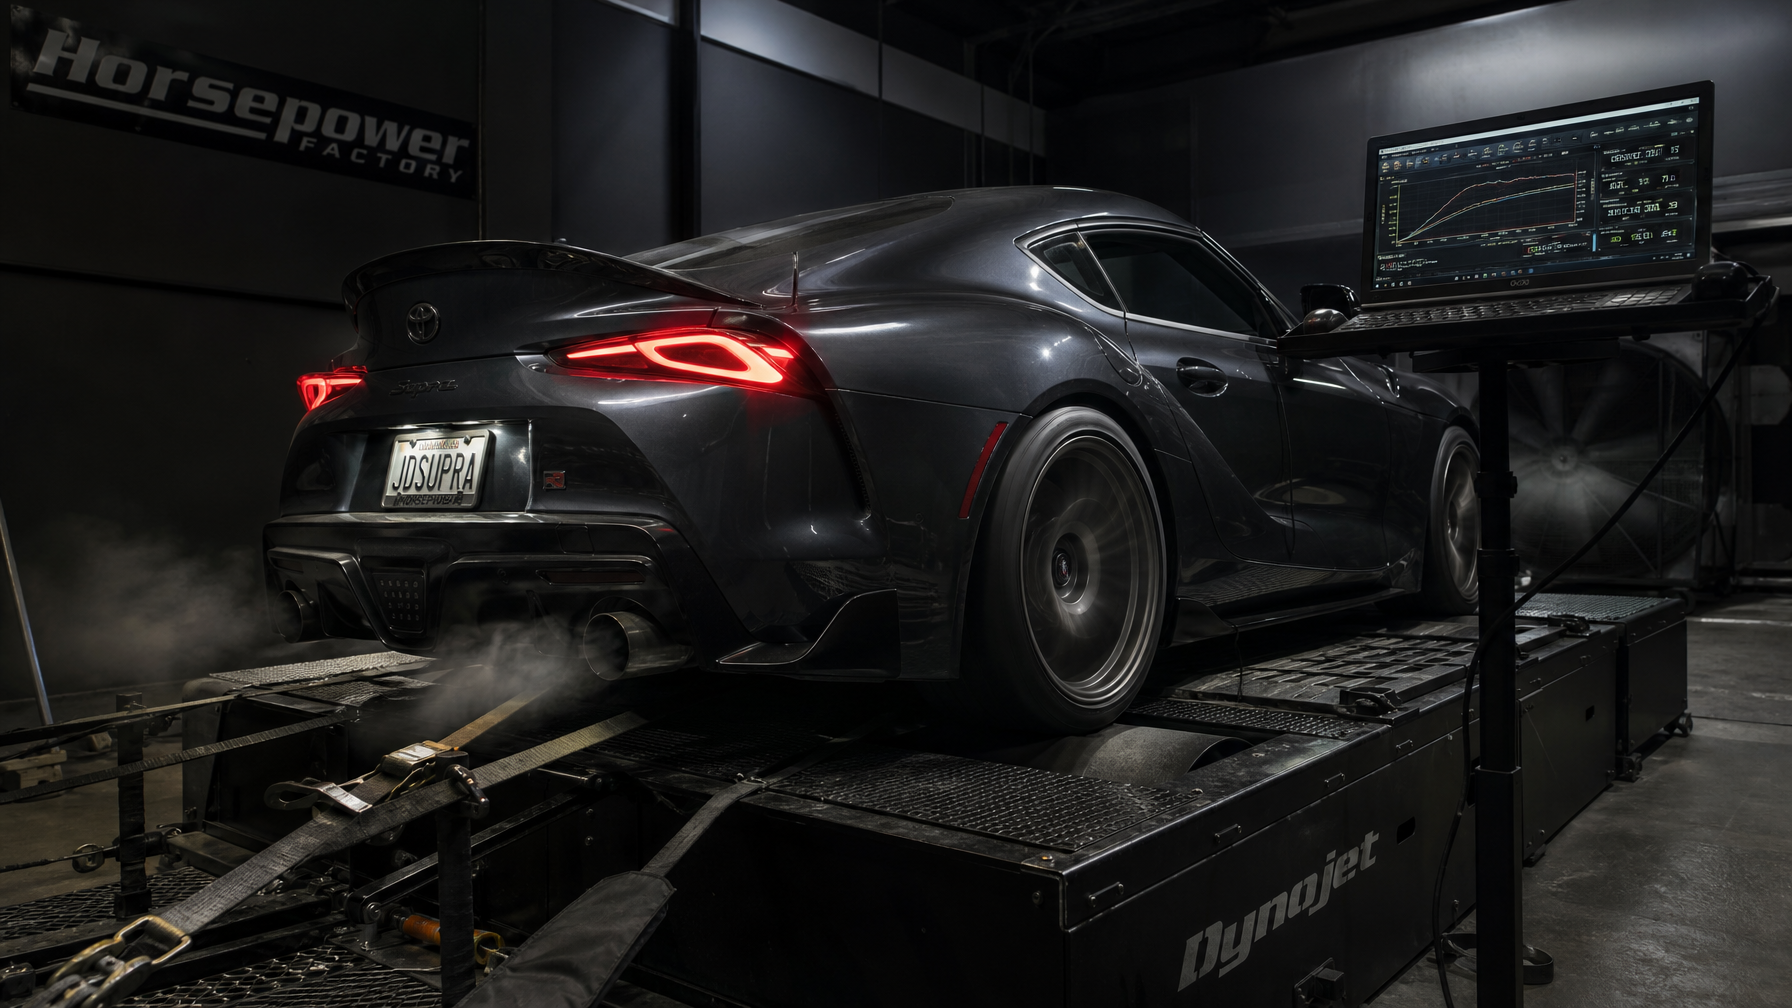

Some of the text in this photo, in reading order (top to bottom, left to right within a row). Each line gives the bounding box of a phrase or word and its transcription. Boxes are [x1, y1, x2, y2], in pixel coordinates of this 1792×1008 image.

[33, 28, 469, 165] Horsepower
[299, 136, 464, 183] FACTORY
[392, 452, 476, 492] JDSUPRA
[1177, 830, 1380, 992] Dynojet
